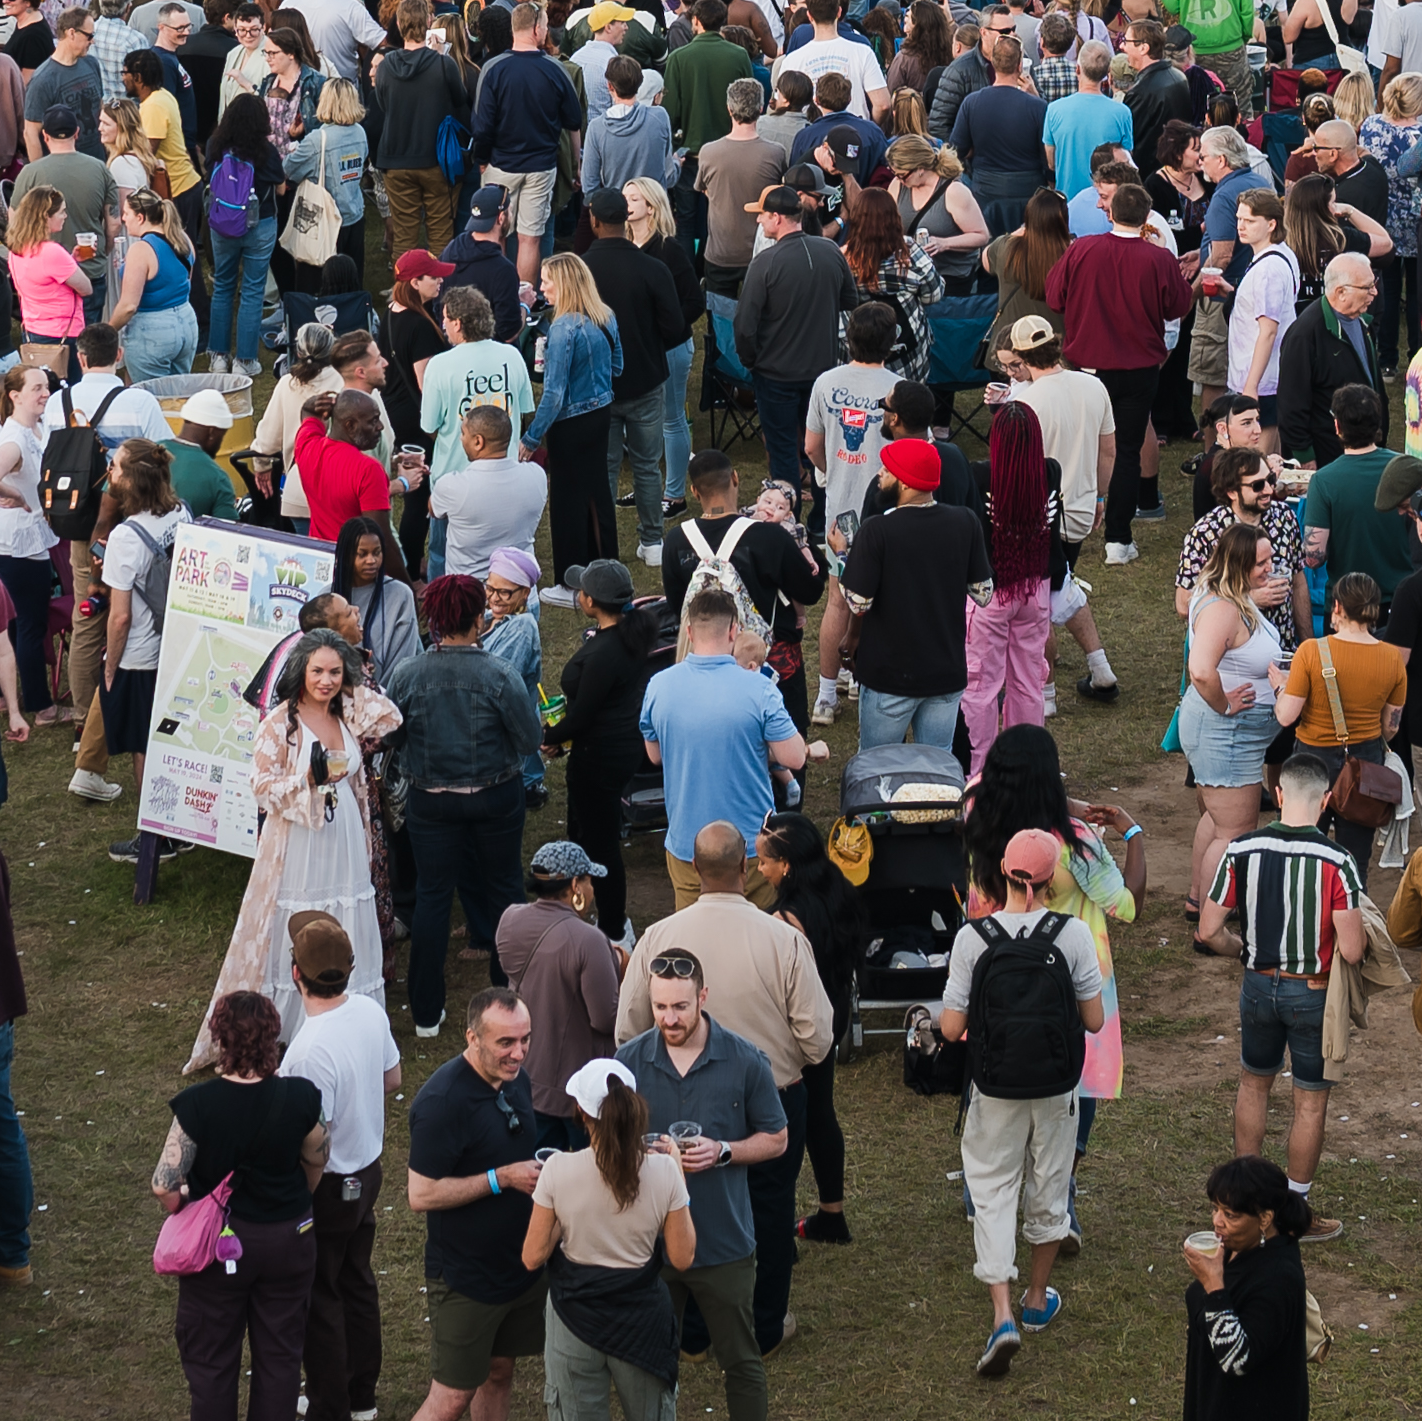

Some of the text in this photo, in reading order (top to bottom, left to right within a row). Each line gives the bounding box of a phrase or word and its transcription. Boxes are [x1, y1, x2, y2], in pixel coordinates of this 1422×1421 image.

[465, 363, 510, 396] feel
[831, 387, 881, 411] Coors
[836, 448, 867, 465] RODEO
[179, 547, 208, 569] ART
[175, 565, 210, 588] PARK
[273, 566, 307, 589] VIP
[270, 586, 309, 603] SKYDECK
[162, 754, 208, 775] LET'S RACE!
[184, 796, 206, 810] DASH
[185, 786, 218, 802] DUNKIN'
